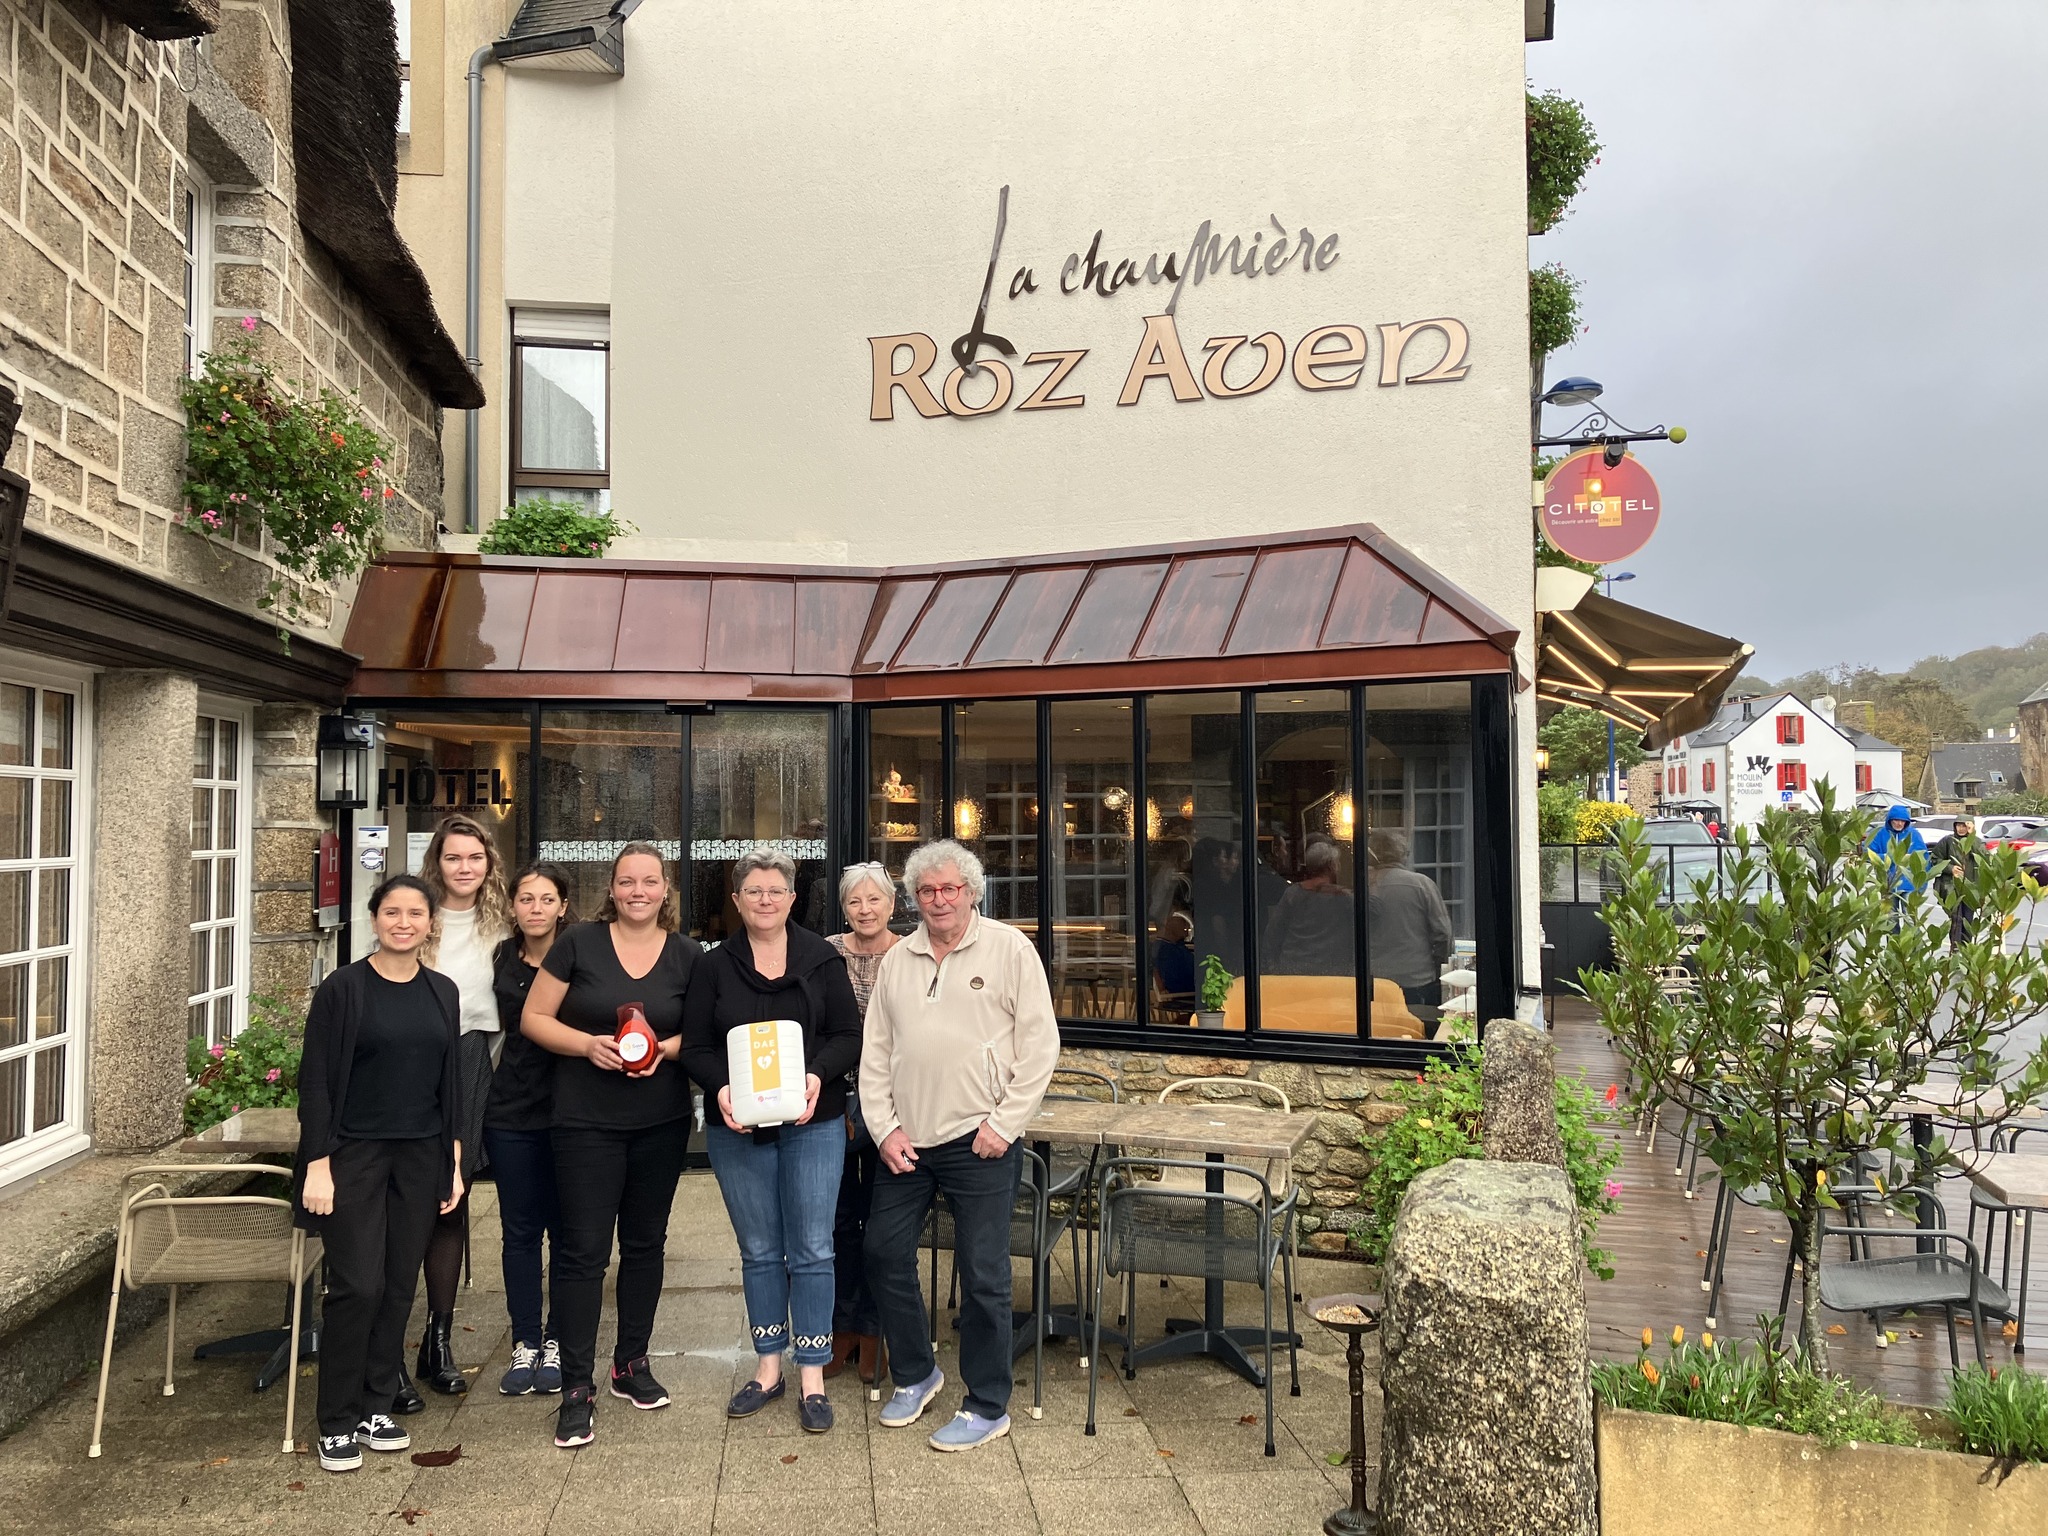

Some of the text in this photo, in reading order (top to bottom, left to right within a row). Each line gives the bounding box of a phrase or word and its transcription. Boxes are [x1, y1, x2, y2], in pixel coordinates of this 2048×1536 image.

[951, 184, 1039, 377] La
[866, 313, 1473, 421] Roz Aven
[1549, 499, 1655, 516] CITOTEL
[1737, 773, 1763, 781] MOULIN
[753, 1039, 776, 1050] DAE
